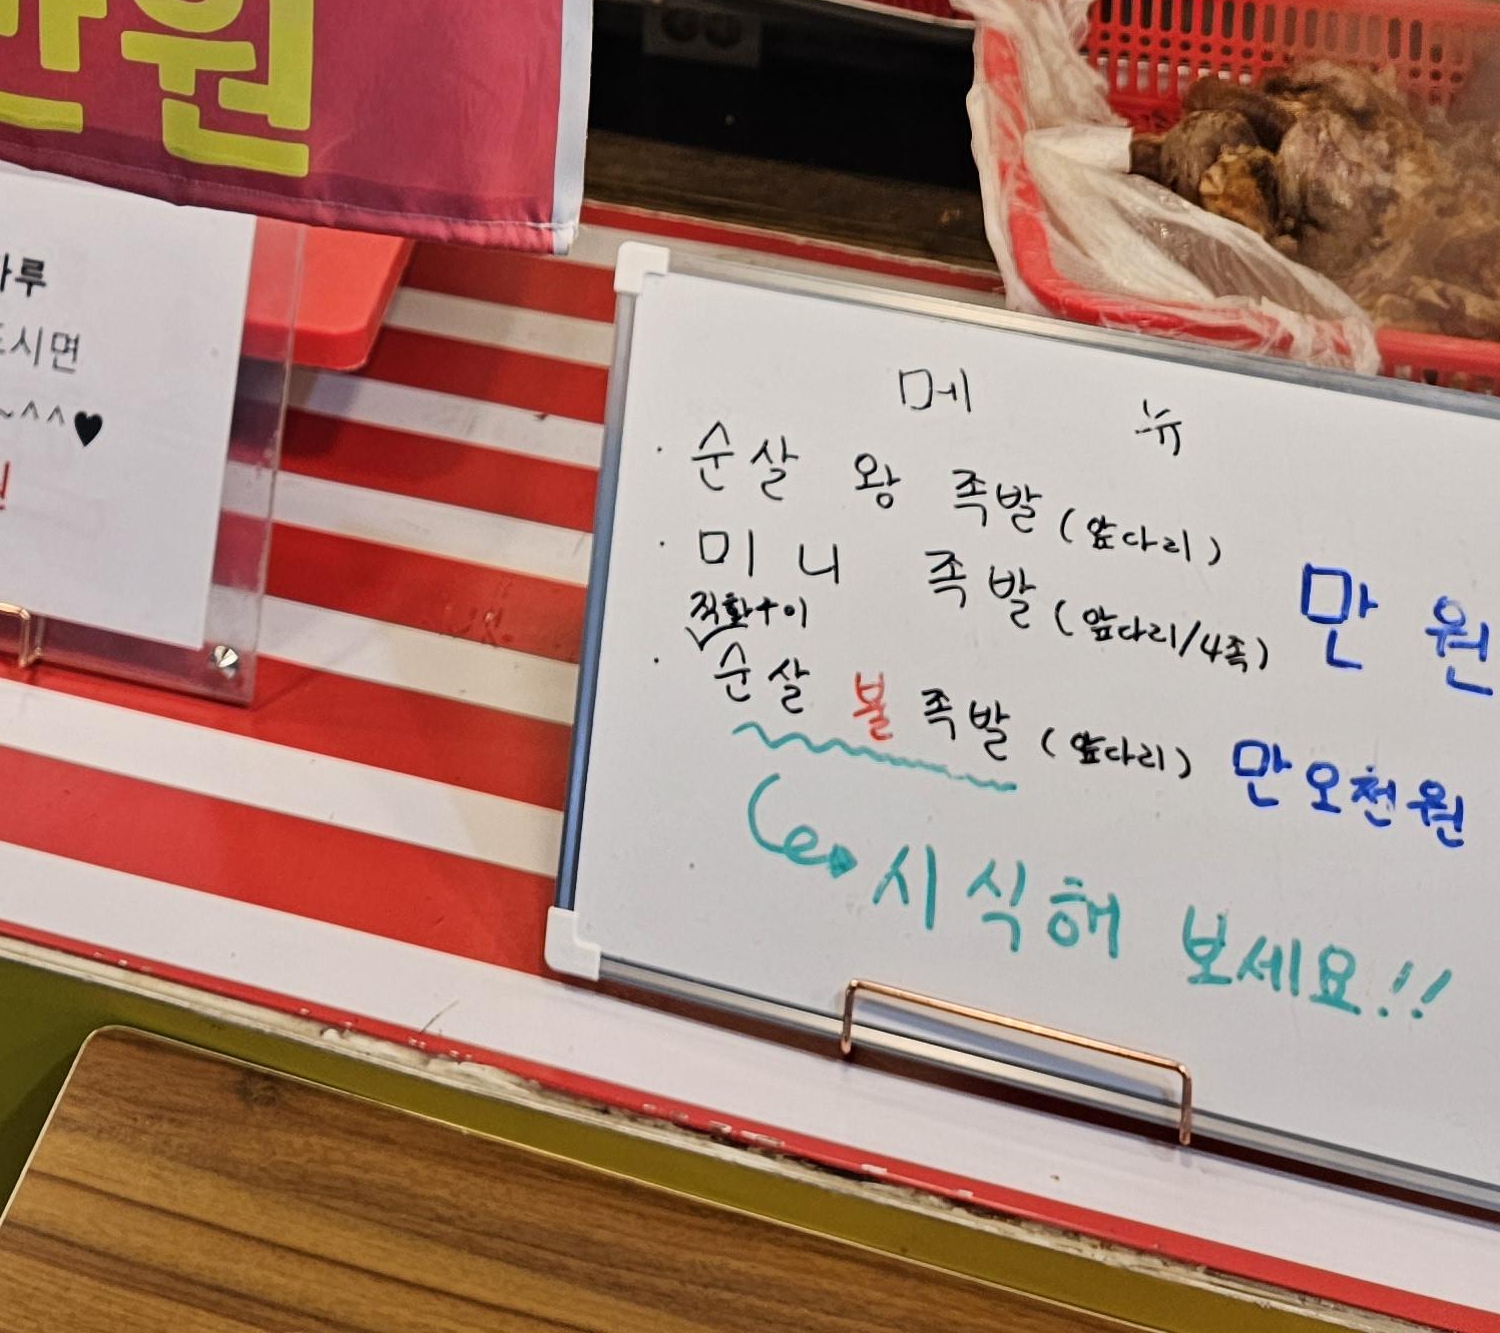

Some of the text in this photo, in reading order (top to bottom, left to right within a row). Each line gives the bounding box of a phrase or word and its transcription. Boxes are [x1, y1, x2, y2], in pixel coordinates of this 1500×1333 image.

[691, 420, 800, 502] 순살
[854, 453, 902, 509] 왕
[951, 468, 1043, 534] 족발
[713, 641, 811, 715] 순살
[852, 671, 895, 744] 불
[921, 687, 1012, 763] 족발
